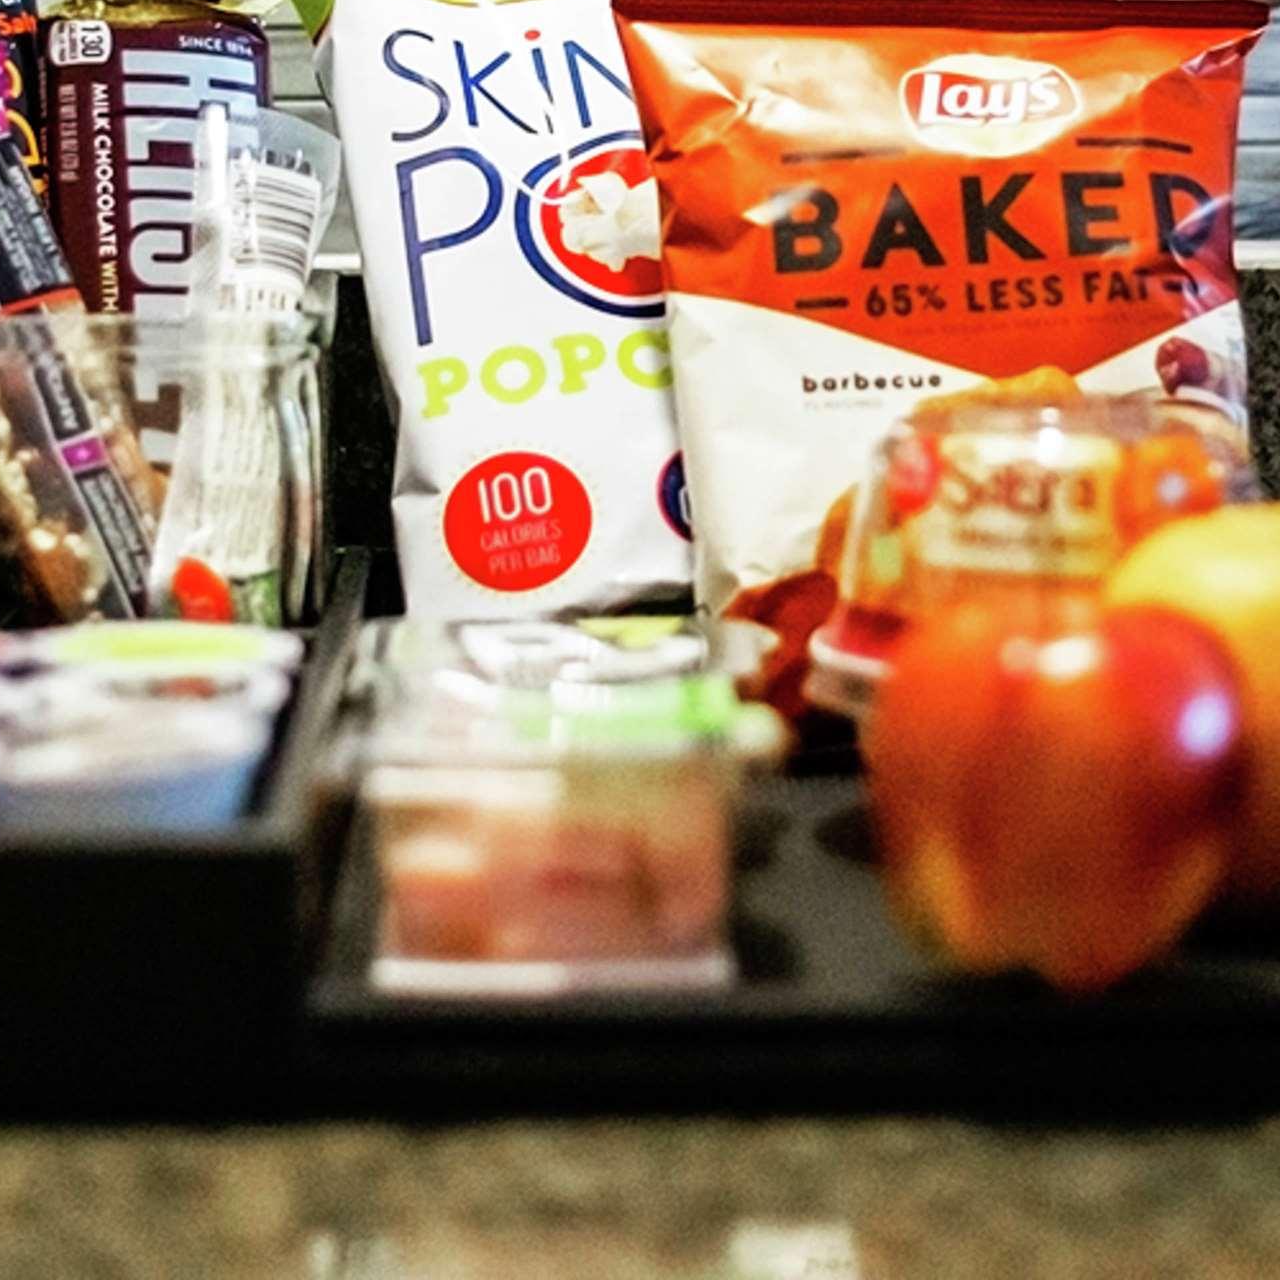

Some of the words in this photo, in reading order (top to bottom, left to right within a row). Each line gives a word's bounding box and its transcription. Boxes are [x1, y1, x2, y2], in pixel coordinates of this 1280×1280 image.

[80, 25, 105, 59] 130
[178, 35, 222, 51] SINCE
[91, 83, 111, 132] MILK
[93, 134, 119, 257] CHOCOLATE
[773, 172, 1216, 274] BAKED
[101, 260, 119, 314] WITH
[865, 282, 947, 318] 65%
[966, 275, 1065, 313] LESS
[1083, 267, 1154, 305] FAT
[802, 372, 942, 394] barbecue
[477, 466, 552, 524] 100
[479, 520, 563, 552] CALORIES
[488, 549, 522, 576] PER
[525, 544, 562, 570] BAG
